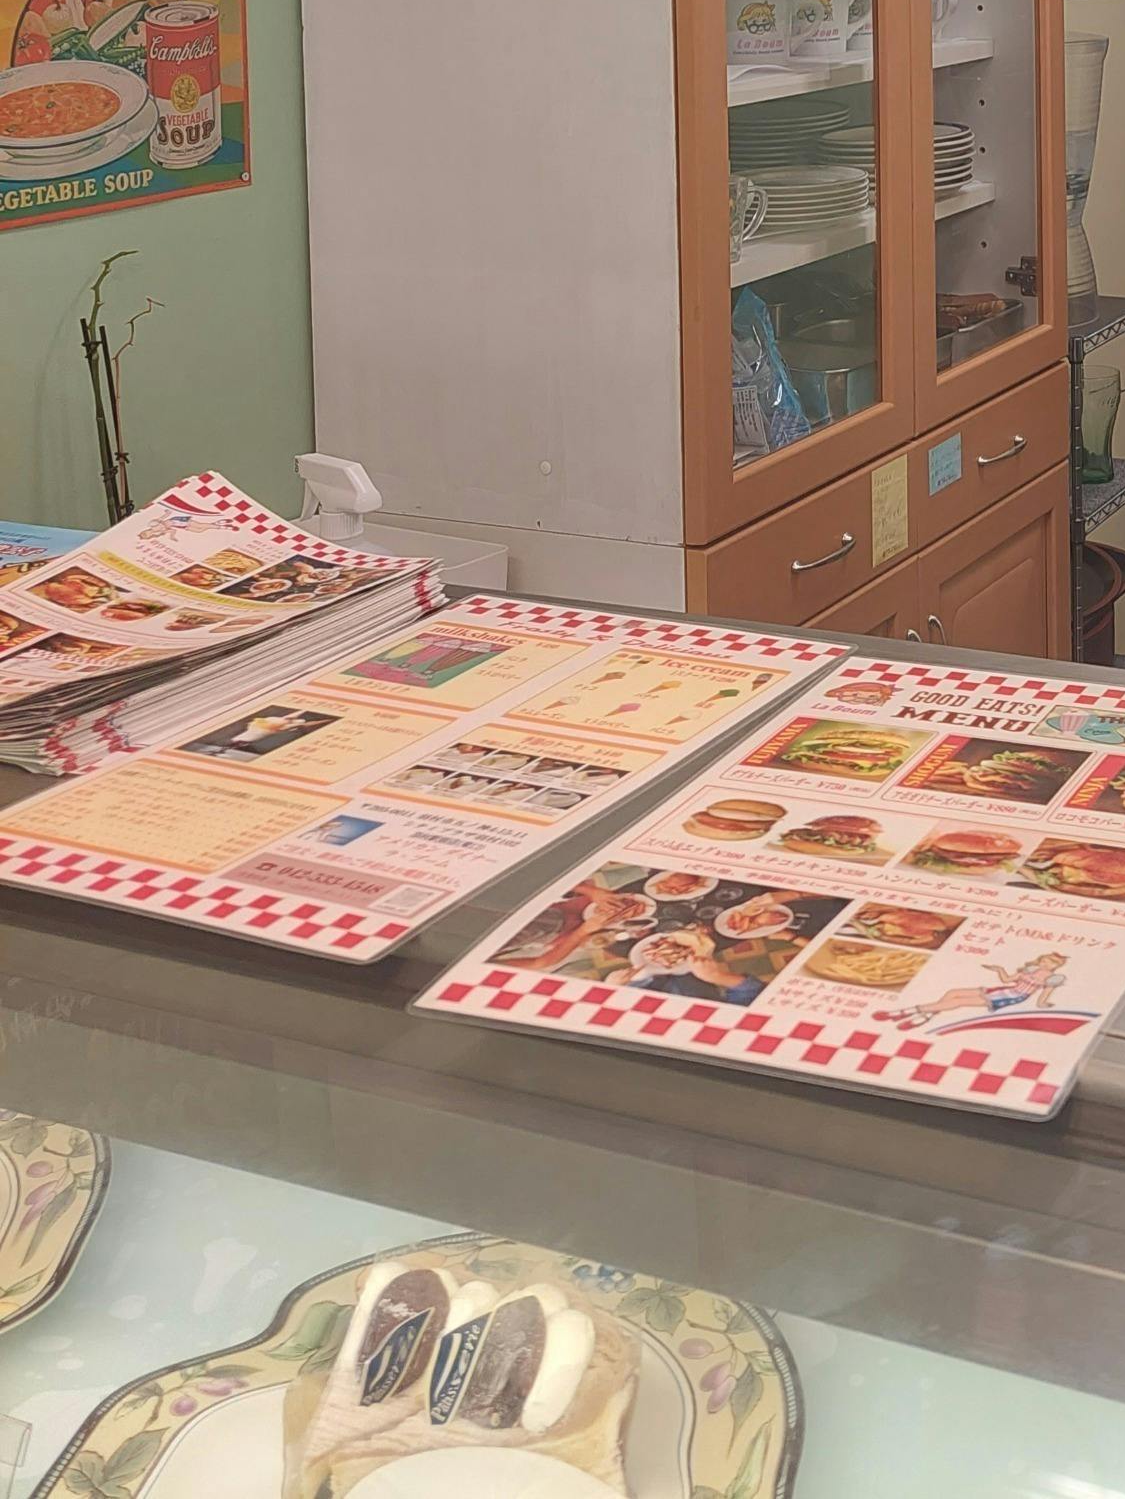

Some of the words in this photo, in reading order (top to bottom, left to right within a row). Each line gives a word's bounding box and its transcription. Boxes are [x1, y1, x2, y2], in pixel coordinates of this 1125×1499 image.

[166, 108, 209, 126] VEGETABLE
[157, 116, 215, 147] SOUP
[104, 169, 154, 194] SOUP
[429, 626, 527, 646] milkshakes
[659, 659, 690, 669] Ice
[686, 663, 752, 679] cream
[830, 705, 878, 716] Boum
[909, 691, 970, 708] GOOD
[973, 698, 1048, 717] EATS!
[890, 705, 1037, 733] MENU
[746, 722, 808, 765] FUJIYAMA
[1069, 776, 1109, 806] NINJA
